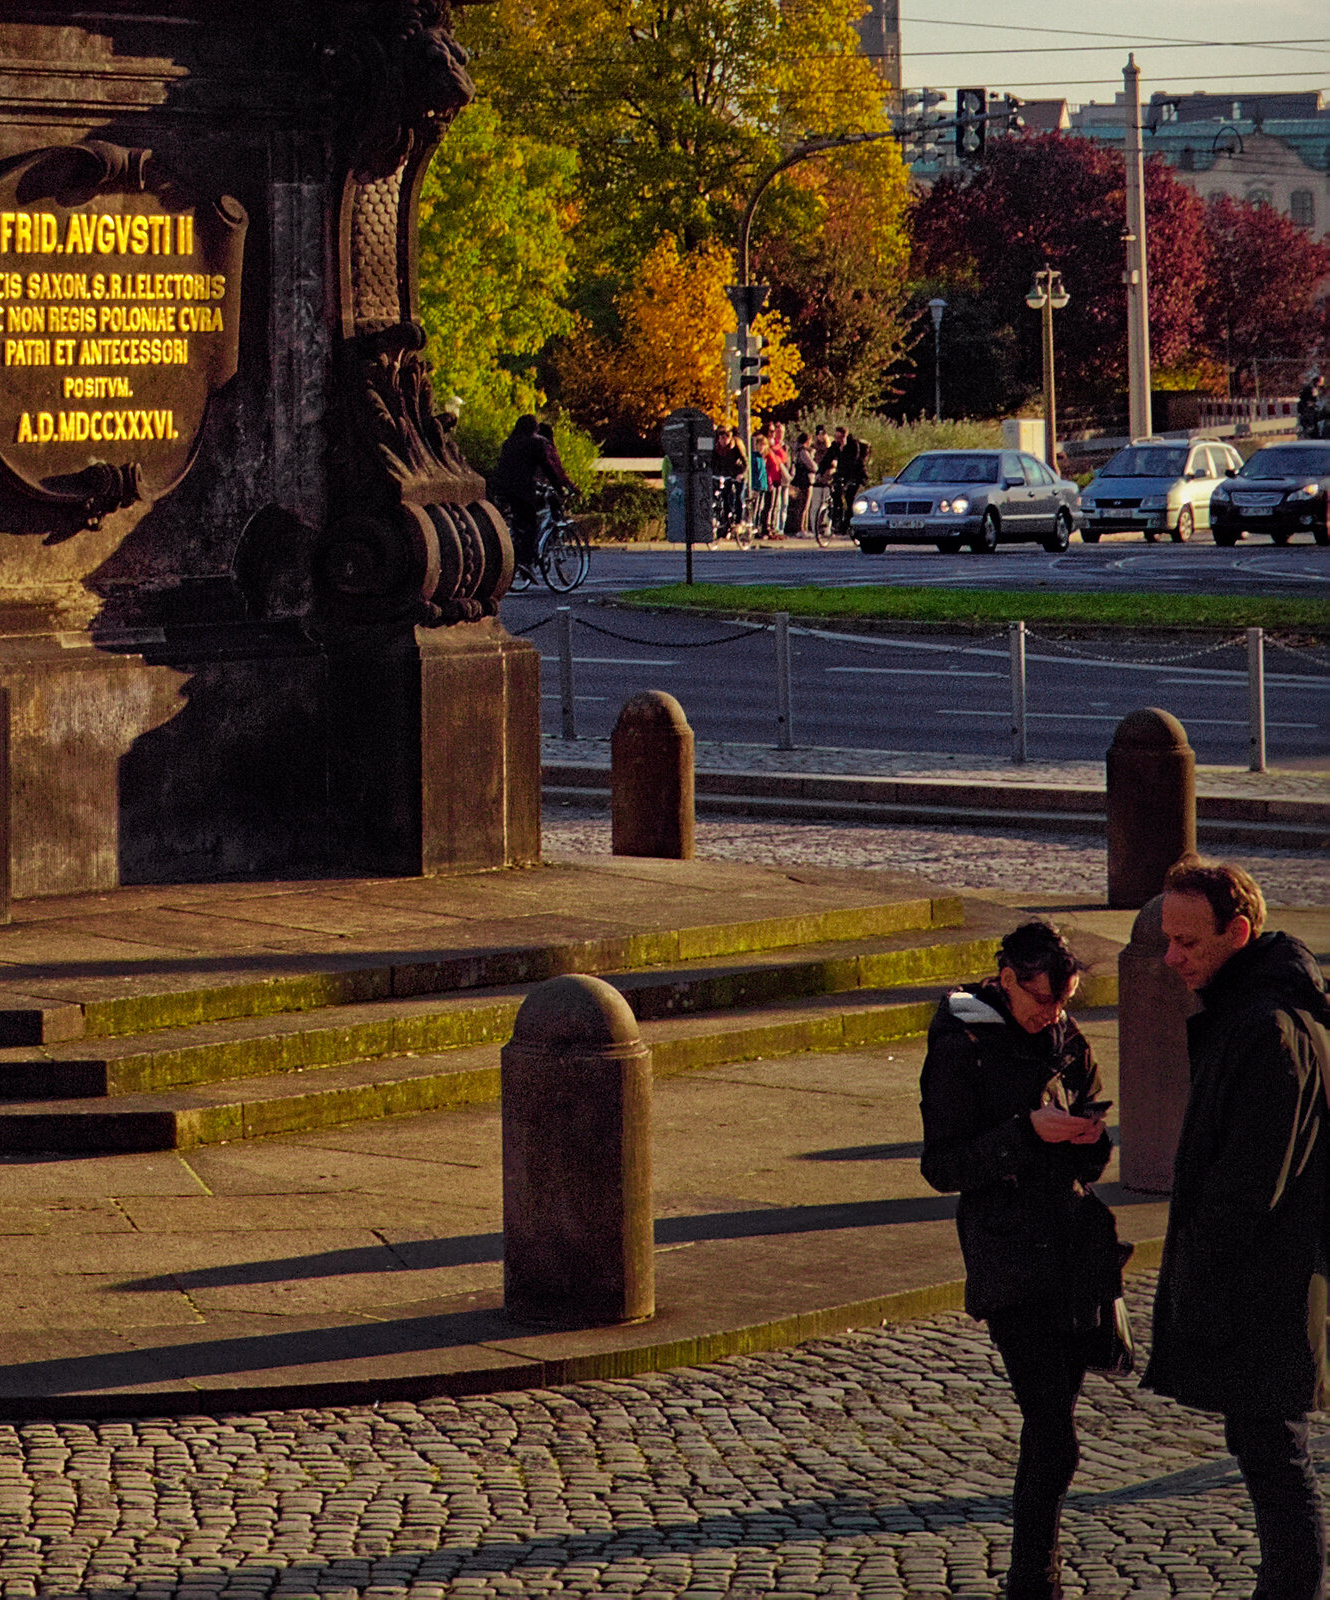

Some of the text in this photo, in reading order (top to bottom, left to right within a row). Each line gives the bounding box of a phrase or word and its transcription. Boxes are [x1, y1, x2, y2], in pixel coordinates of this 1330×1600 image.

[0, 212, 194, 255] FRID. AVGVSTI II
[7, 306, 45, 333] NON
[47, 306, 97, 333] REGIS
[99, 306, 176, 332] POLONIAE
[178, 307, 224, 332] CVRA
[4, 338, 189, 366] PATRI ET ANTECESSORI
[63, 376, 134, 399] POSITVM.
